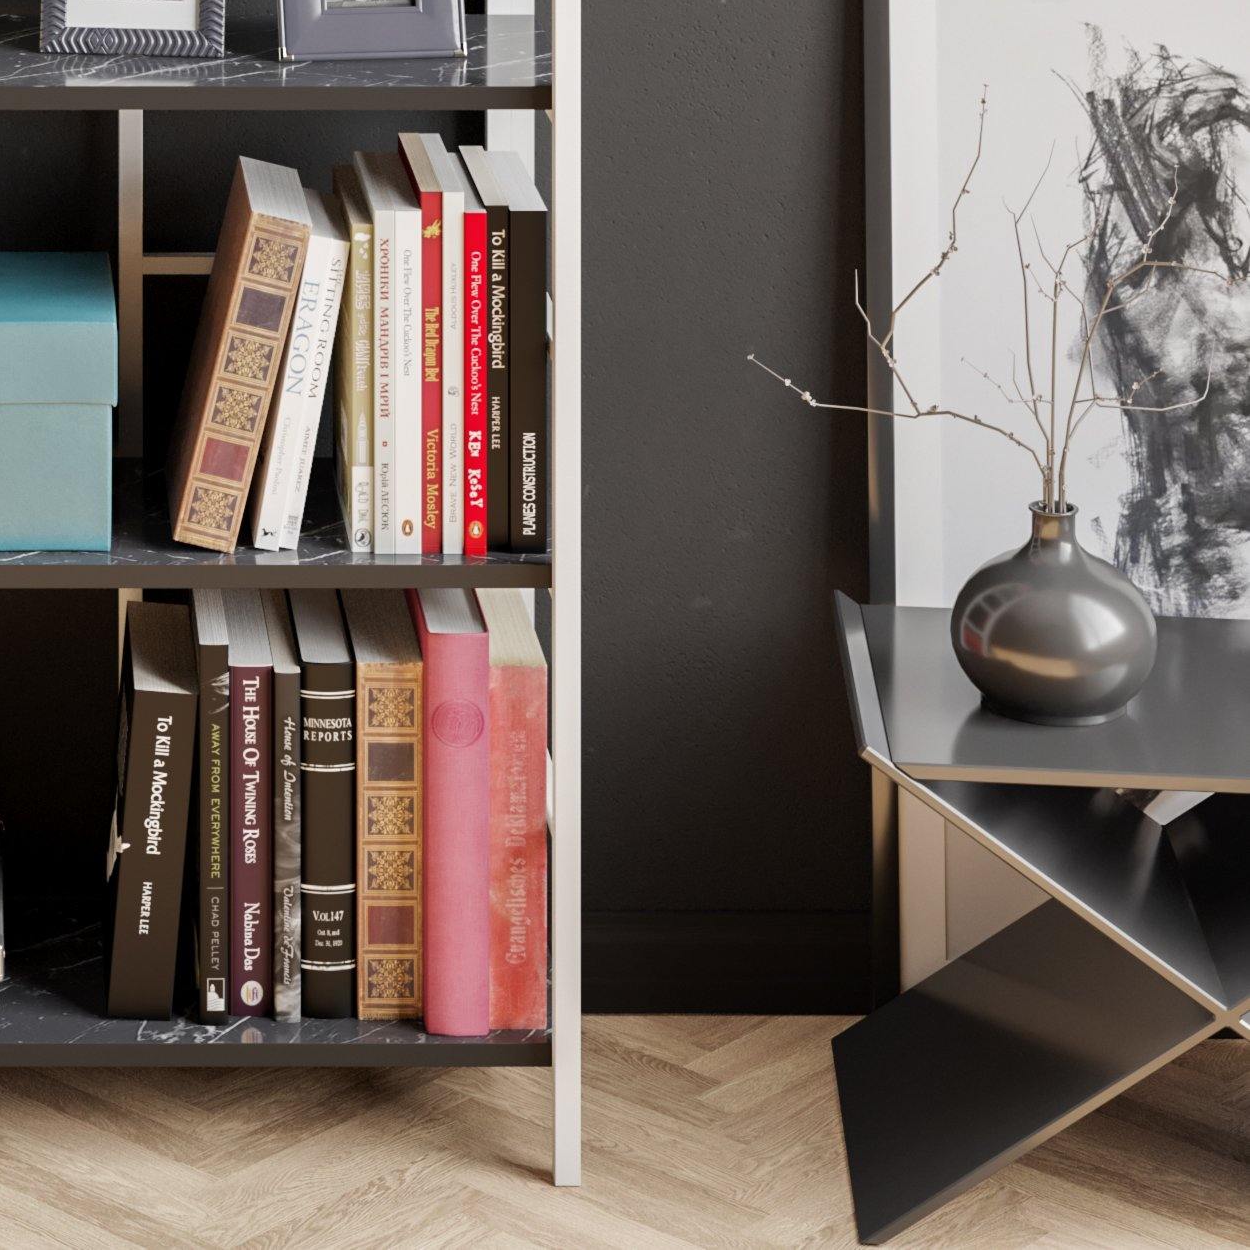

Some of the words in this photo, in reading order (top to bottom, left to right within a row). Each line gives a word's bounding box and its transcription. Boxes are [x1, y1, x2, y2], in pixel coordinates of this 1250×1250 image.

[492, 230, 506, 246] To
[380, 238, 390, 300] ХРОНІКИ
[404, 250, 412, 266] One
[471, 252, 482, 272] One
[492, 250, 506, 270] Kill
[404, 268, 412, 285] Flew
[471, 274, 482, 297] Flew
[320, 259, 342, 333] SITTING
[404, 287, 412, 306] Over
[404, 307, 412, 323] The
[424, 307, 440, 322] The
[471, 300, 482, 324] Over
[488, 284, 506, 368] Mockingbird
[286, 280, 320, 396] ERAGON
[378, 307, 390, 369] МАНДРІВ
[404, 324, 412, 357] Cuckoo's
[424, 323, 440, 338] Red
[471, 326, 482, 345] The
[423, 338, 440, 366] Dragon
[308, 338, 327, 398] ROOM
[404, 360, 412, 376] Nest
[424, 368, 440, 382] Bed
[471, 348, 482, 390] Cuckoo's
[380, 382, 391, 418] МРІЙ
[471, 393, 482, 415] Nest
[492, 396, 500, 432] HARPER
[426, 428, 439, 480] Victoria
[492, 434, 500, 450] LEE
[380, 463, 388, 488] Юрій
[522, 432, 536, 501] CONSTRUCTION
[424, 484, 439, 528] Mosley
[522, 502, 536, 536] PLANES
[242, 676, 260, 702] THE
[157, 716, 173, 732] To
[242, 706, 260, 745] HOUSE
[283, 716, 296, 750] House
[303, 717, 352, 728] MINNESOTA
[304, 730, 352, 742] REPORTS
[154, 735, 170, 756] Kill
[211, 724, 220, 756] AWAY
[242, 747, 260, 768] OF
[280, 753, 296, 768] of
[211, 760, 220, 793] FROM
[242, 771, 260, 825] TWINING
[284, 770, 296, 821] Intention
[144, 770, 168, 855] Mockingbird
[211, 798, 220, 878] EVERYWHERE
[242, 828, 260, 864] ROSES
[140, 881, 152, 917] HARPER
[211, 896, 220, 927] CHAD
[284, 886, 294, 932] Valentine
[139, 919, 150, 935] LEE
[244, 902, 260, 946] Nabina
[211, 931, 220, 971] PELLEY
[244, 948, 260, 970] Das
